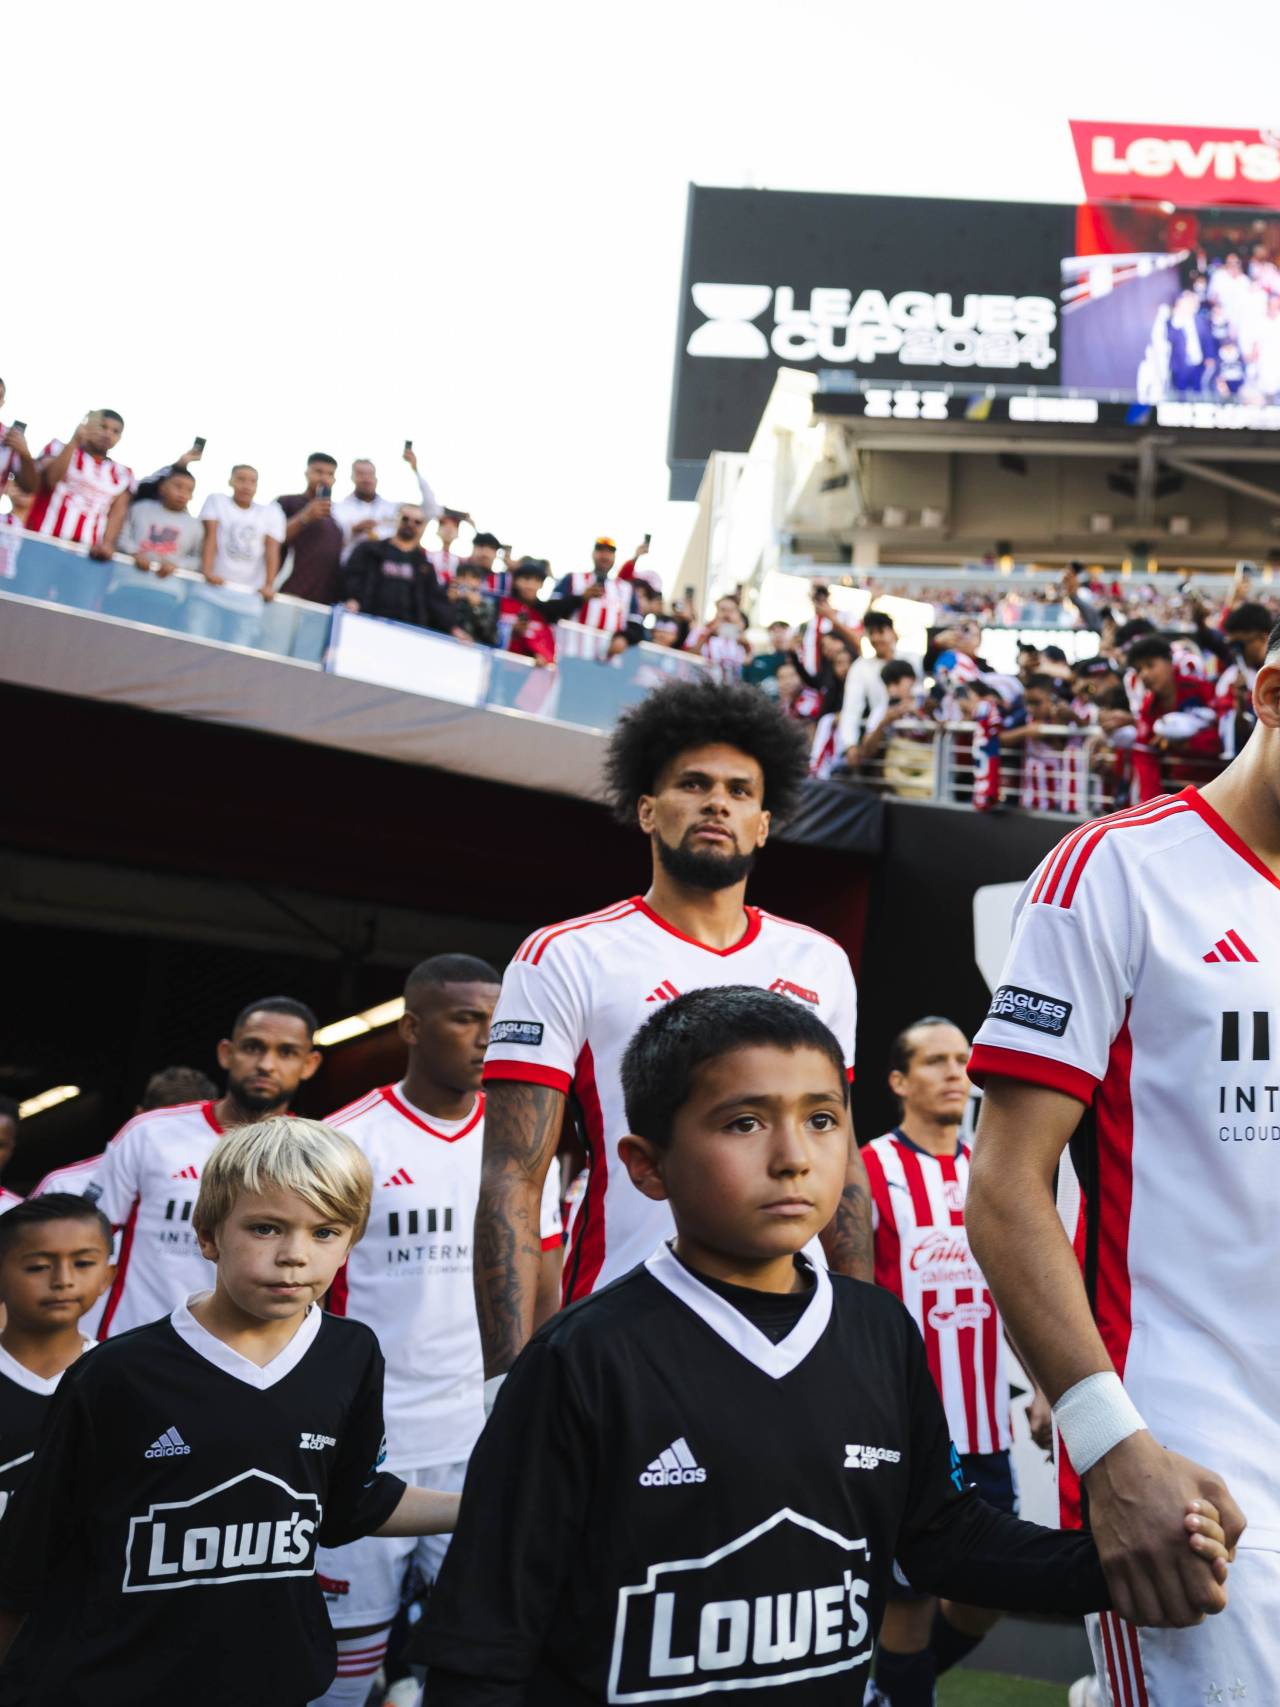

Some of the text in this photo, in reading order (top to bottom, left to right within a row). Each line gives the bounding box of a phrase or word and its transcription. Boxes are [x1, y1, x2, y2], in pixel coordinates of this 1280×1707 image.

[774, 286, 1057, 335] LEAGUES
[771, 322, 1056, 369] CUP 2024
[1012, 1006, 1062, 1031] 2024
[144, 1444, 191, 1459] adidas
[638, 1466, 708, 1487] adidas
[148, 1511, 316, 1577] LOWE'S
[648, 1569, 871, 1678] LOWE'S
